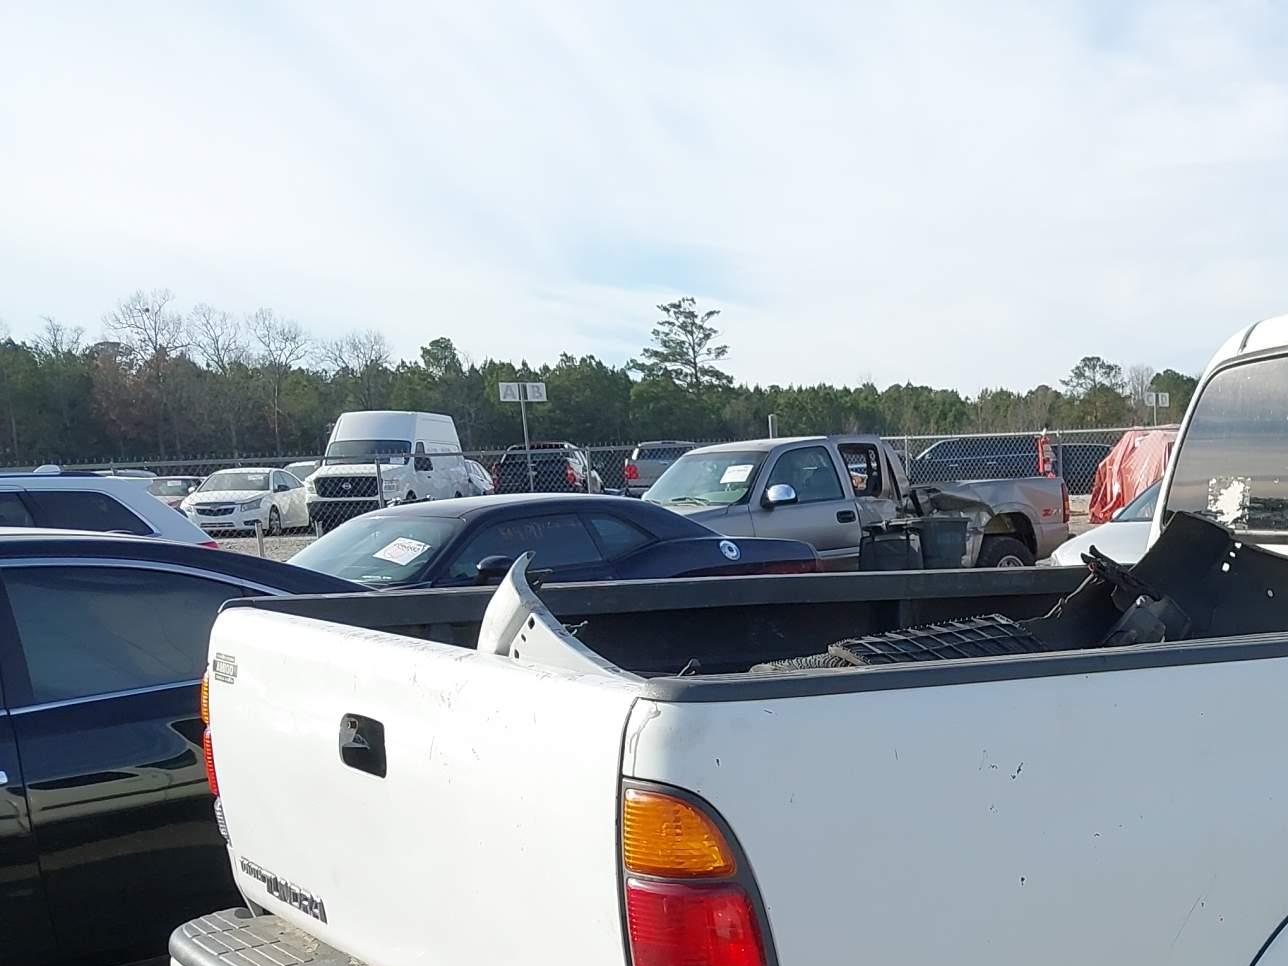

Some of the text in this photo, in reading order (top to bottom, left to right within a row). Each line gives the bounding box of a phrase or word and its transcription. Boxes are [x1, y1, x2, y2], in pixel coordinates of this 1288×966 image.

[502, 384, 517, 399] A
[531, 384, 543, 400] B
[266, 874, 328, 925] TUNDRA
